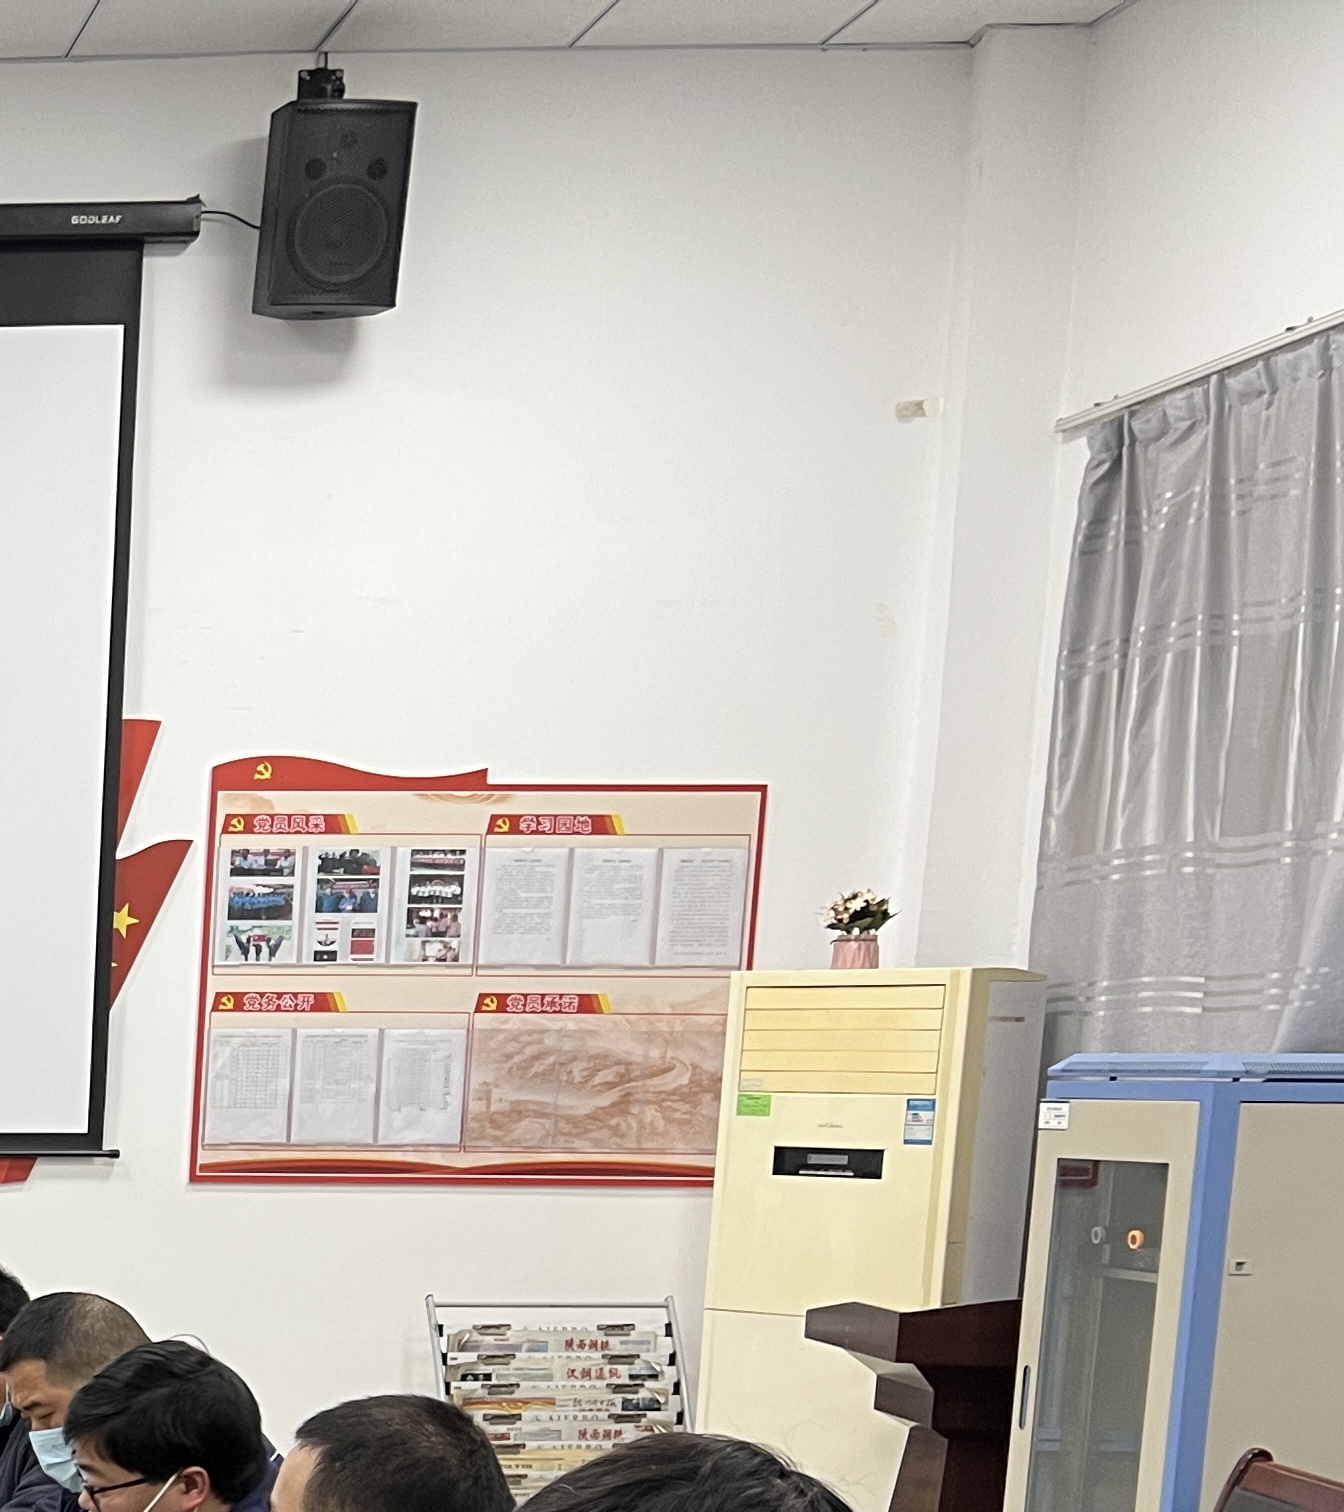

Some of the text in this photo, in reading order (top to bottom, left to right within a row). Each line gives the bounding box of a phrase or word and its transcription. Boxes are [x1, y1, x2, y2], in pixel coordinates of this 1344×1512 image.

[253, 815, 326, 833] 党员风采
[519, 816, 592, 833] 学习园地
[243, 993, 315, 1011] 党务公开
[506, 993, 579, 1013] 党员承诺
